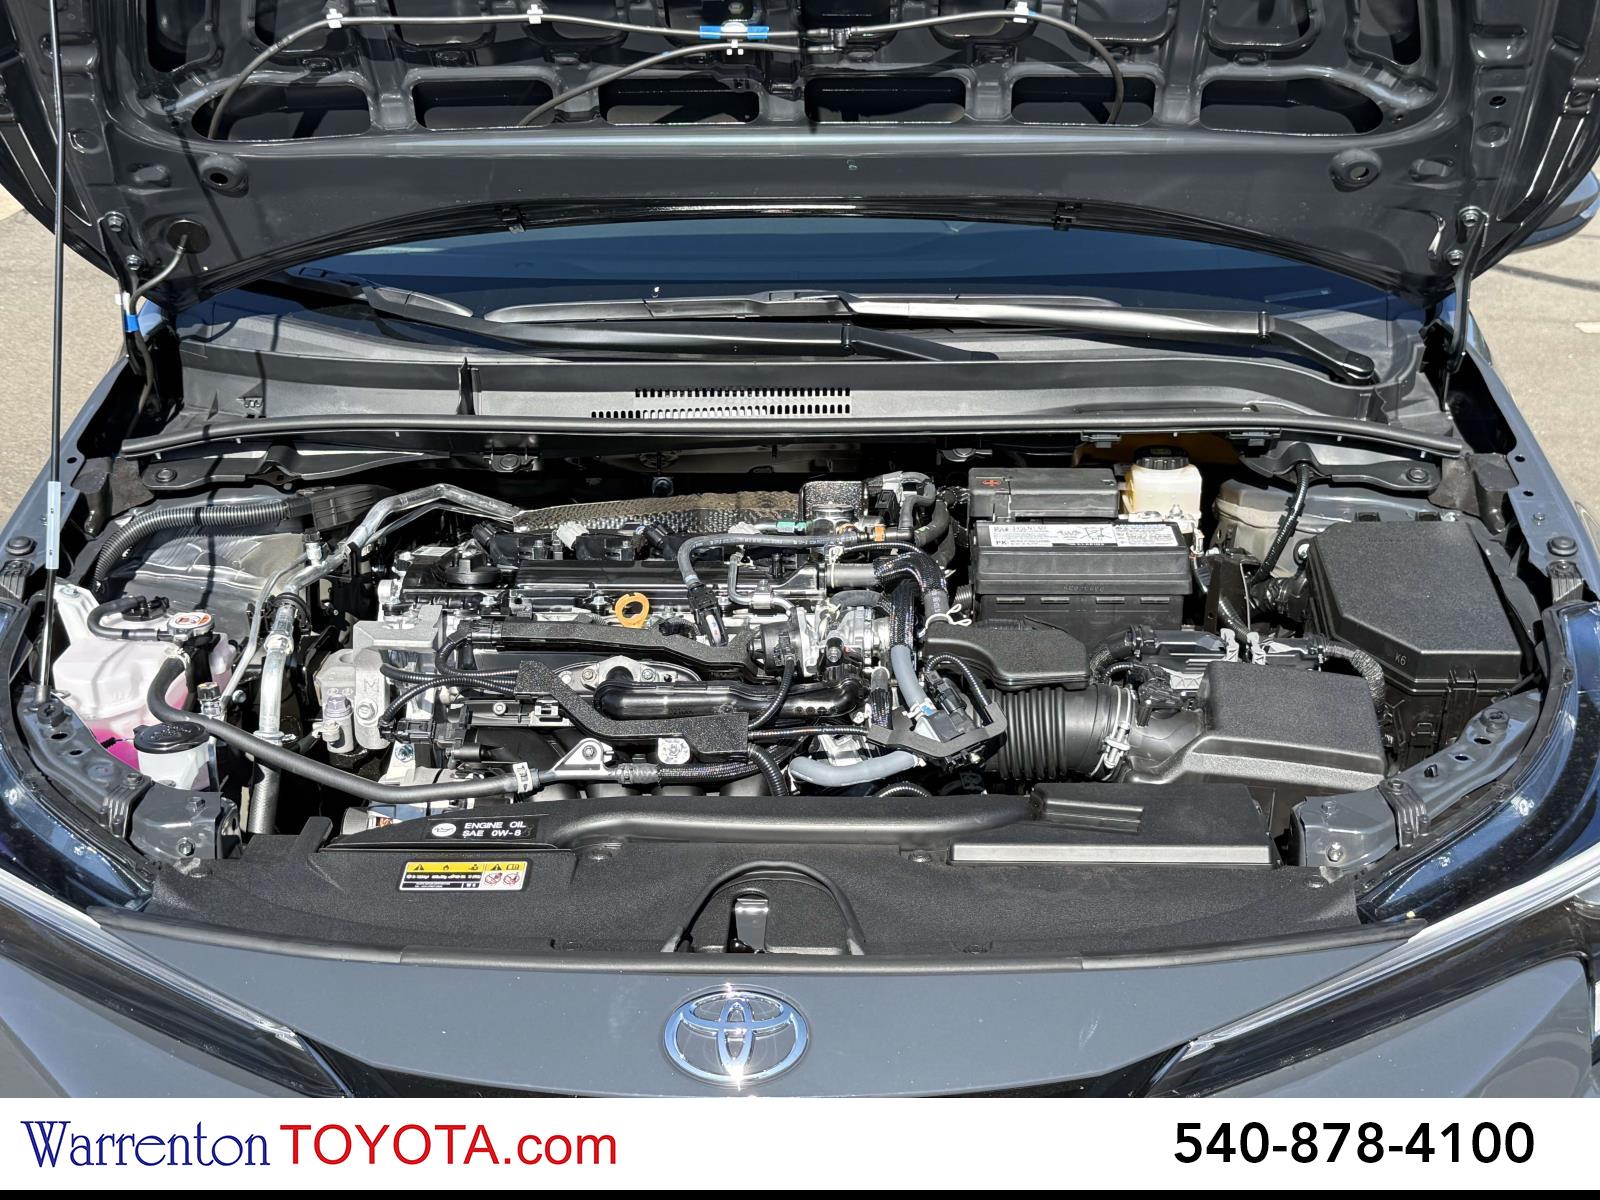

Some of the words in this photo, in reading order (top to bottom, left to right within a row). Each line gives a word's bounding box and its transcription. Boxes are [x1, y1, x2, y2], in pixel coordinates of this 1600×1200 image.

[464, 821, 504, 830] ENGINE
[509, 820, 527, 829] OIL
[462, 829, 485, 838] SAE
